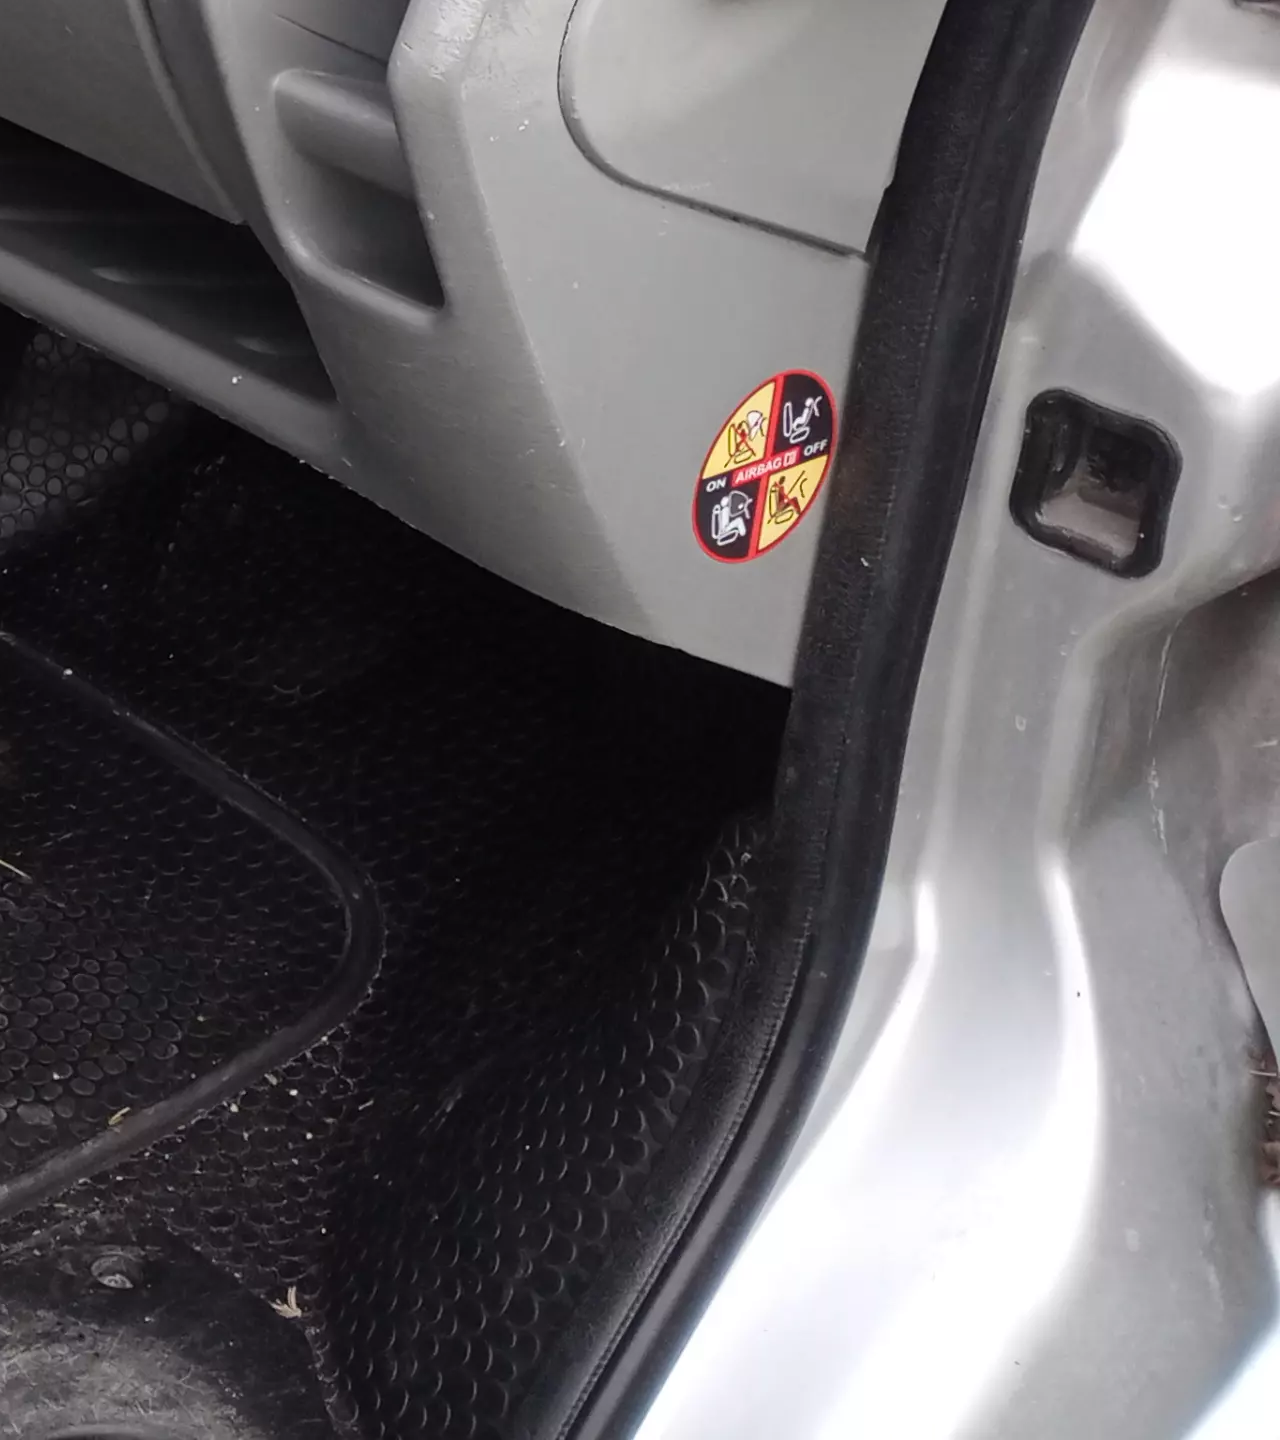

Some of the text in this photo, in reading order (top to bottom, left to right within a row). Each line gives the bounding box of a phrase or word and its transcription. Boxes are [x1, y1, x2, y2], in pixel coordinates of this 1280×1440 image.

[705, 439, 829, 493] ON AIRBAG OFF
